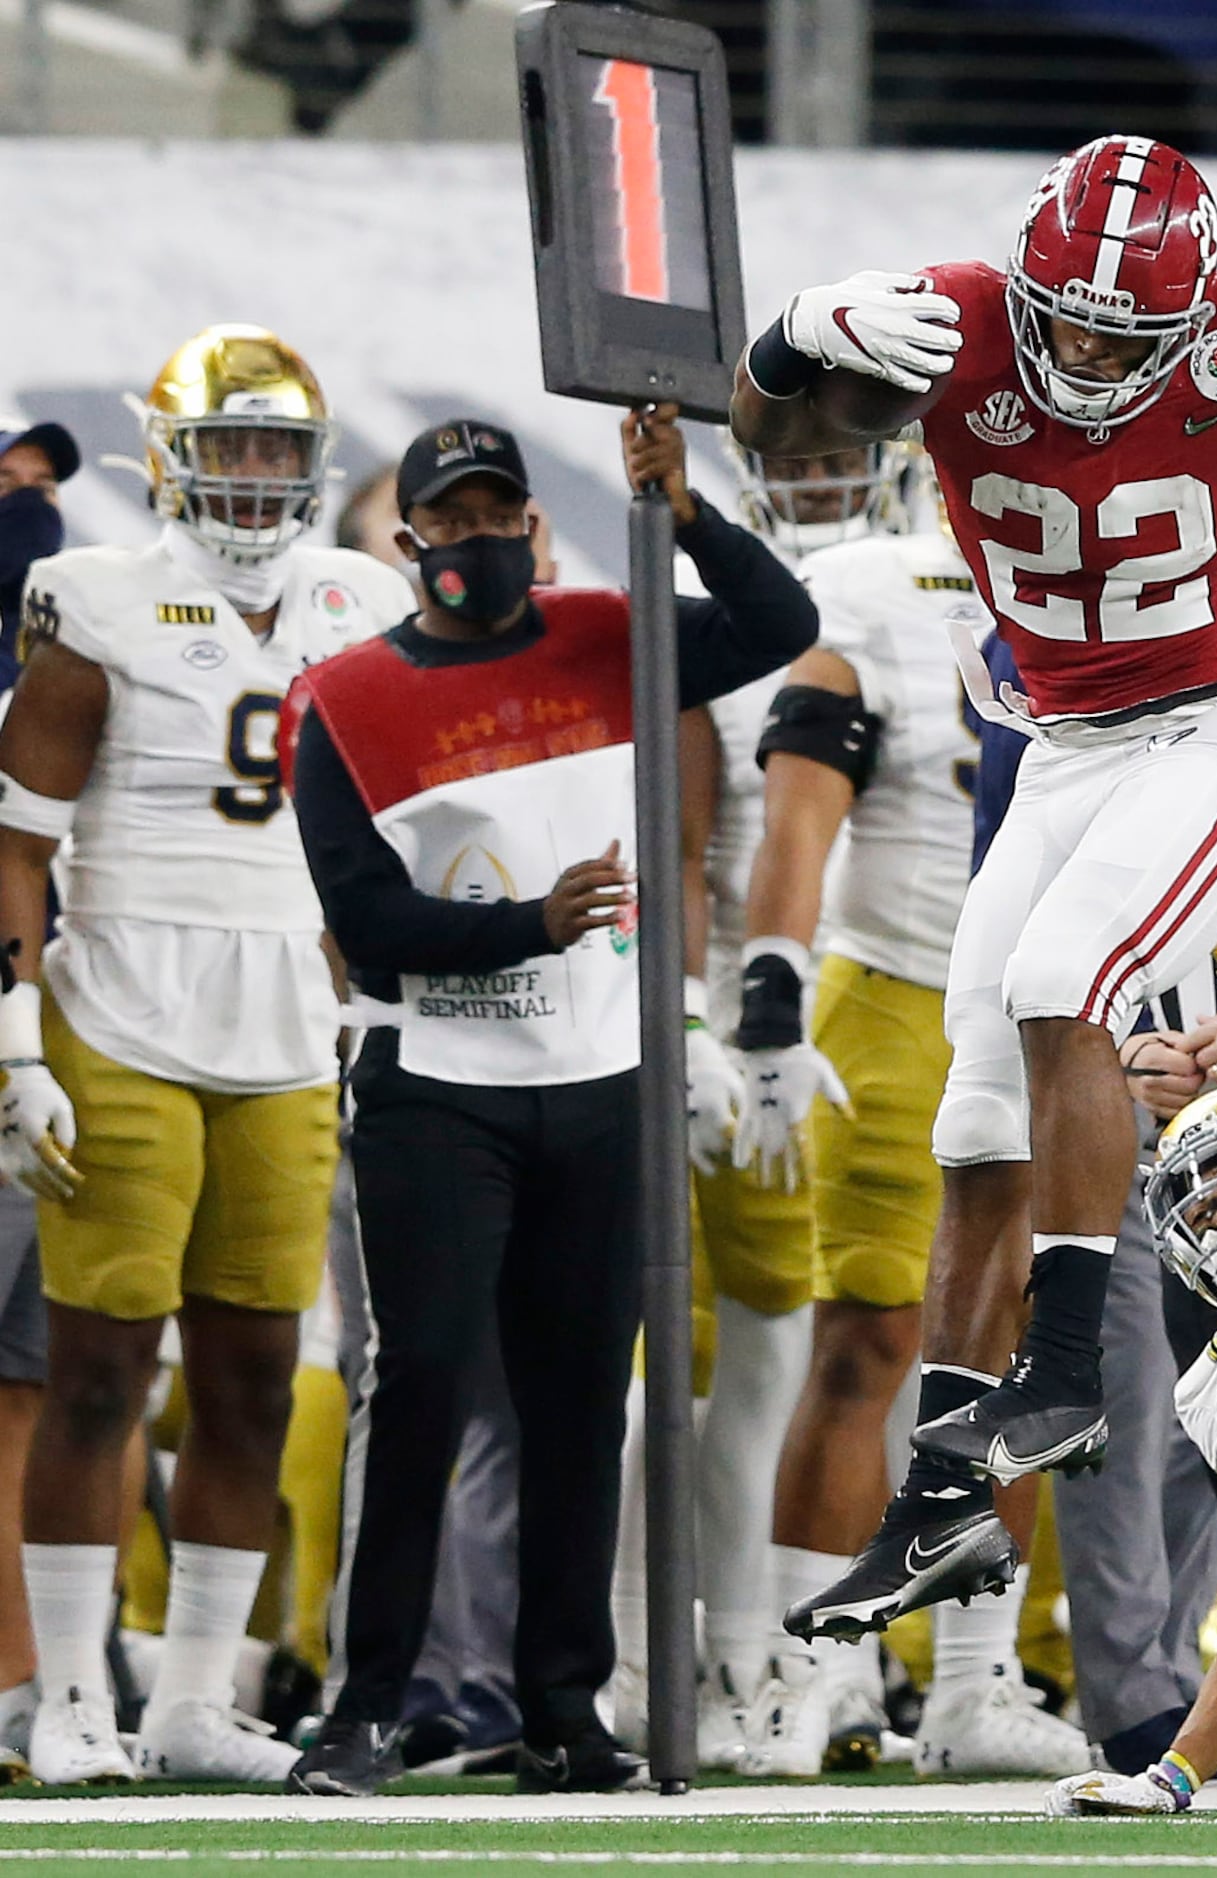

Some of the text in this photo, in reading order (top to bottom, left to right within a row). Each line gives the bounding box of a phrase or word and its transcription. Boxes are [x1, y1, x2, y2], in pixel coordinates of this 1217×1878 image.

[592, 59, 670, 302] 1
[1193, 346, 1206, 376] ROSE
[982, 390, 1026, 431] SEC
[971, 419, 1023, 444] GRADUATE
[970, 472, 1217, 643] 22
[211, 688, 284, 828] 9
[427, 970, 541, 995] PLAYOFF
[419, 996, 557, 1020] SEMIFINAL
